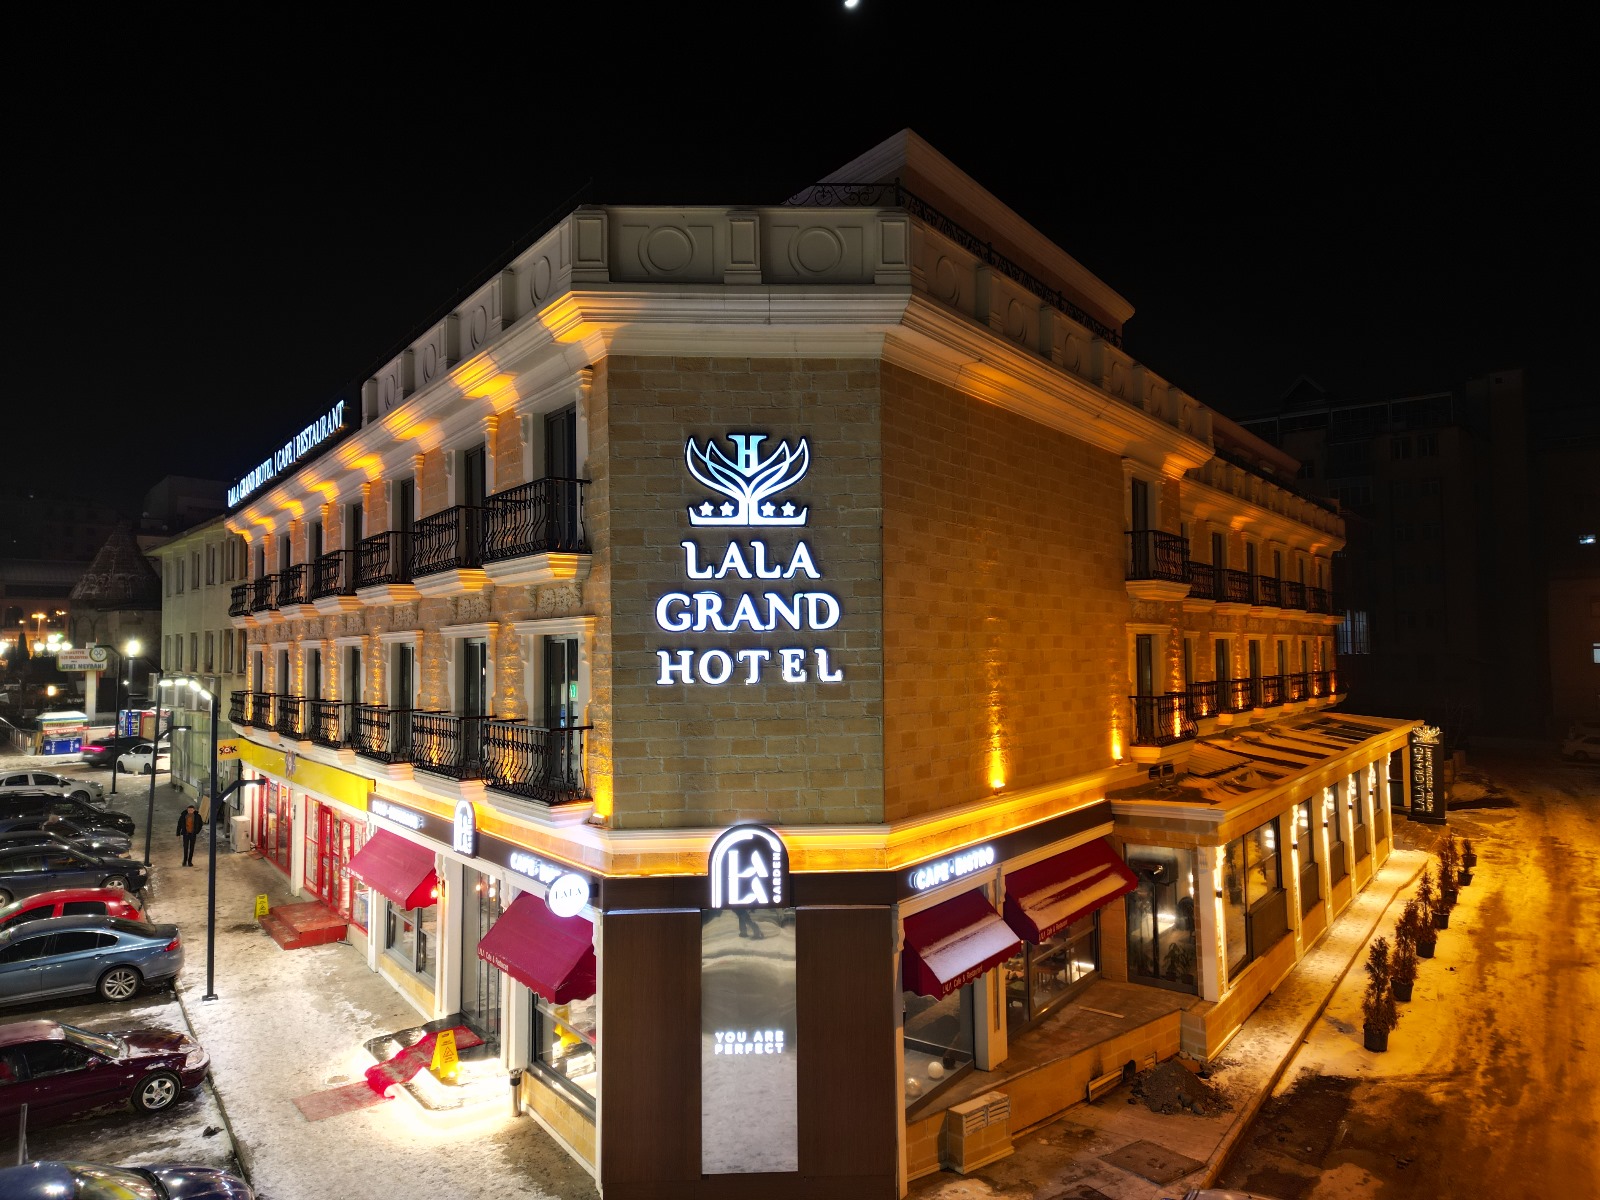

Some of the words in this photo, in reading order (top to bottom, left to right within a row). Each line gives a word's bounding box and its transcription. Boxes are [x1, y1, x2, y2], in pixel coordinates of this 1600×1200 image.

[255, 457, 274, 488] HOTEL
[277, 440, 293, 472] CAFE
[296, 399, 345, 459] RESTAURANT
[680, 540, 821, 580] LALA
[655, 592, 841, 632] GRAND
[656, 648, 843, 685] HOTEL
[1413, 746, 1425, 784] GRAND
[1414, 785, 1425, 812] LALA
[772, 851, 782, 904] GARDEN
[914, 861, 951, 891] CAFE
[714, 1031, 747, 1044] YOU
[753, 1030, 784, 1043] ARE
[714, 1042, 784, 1055] PERFECT
